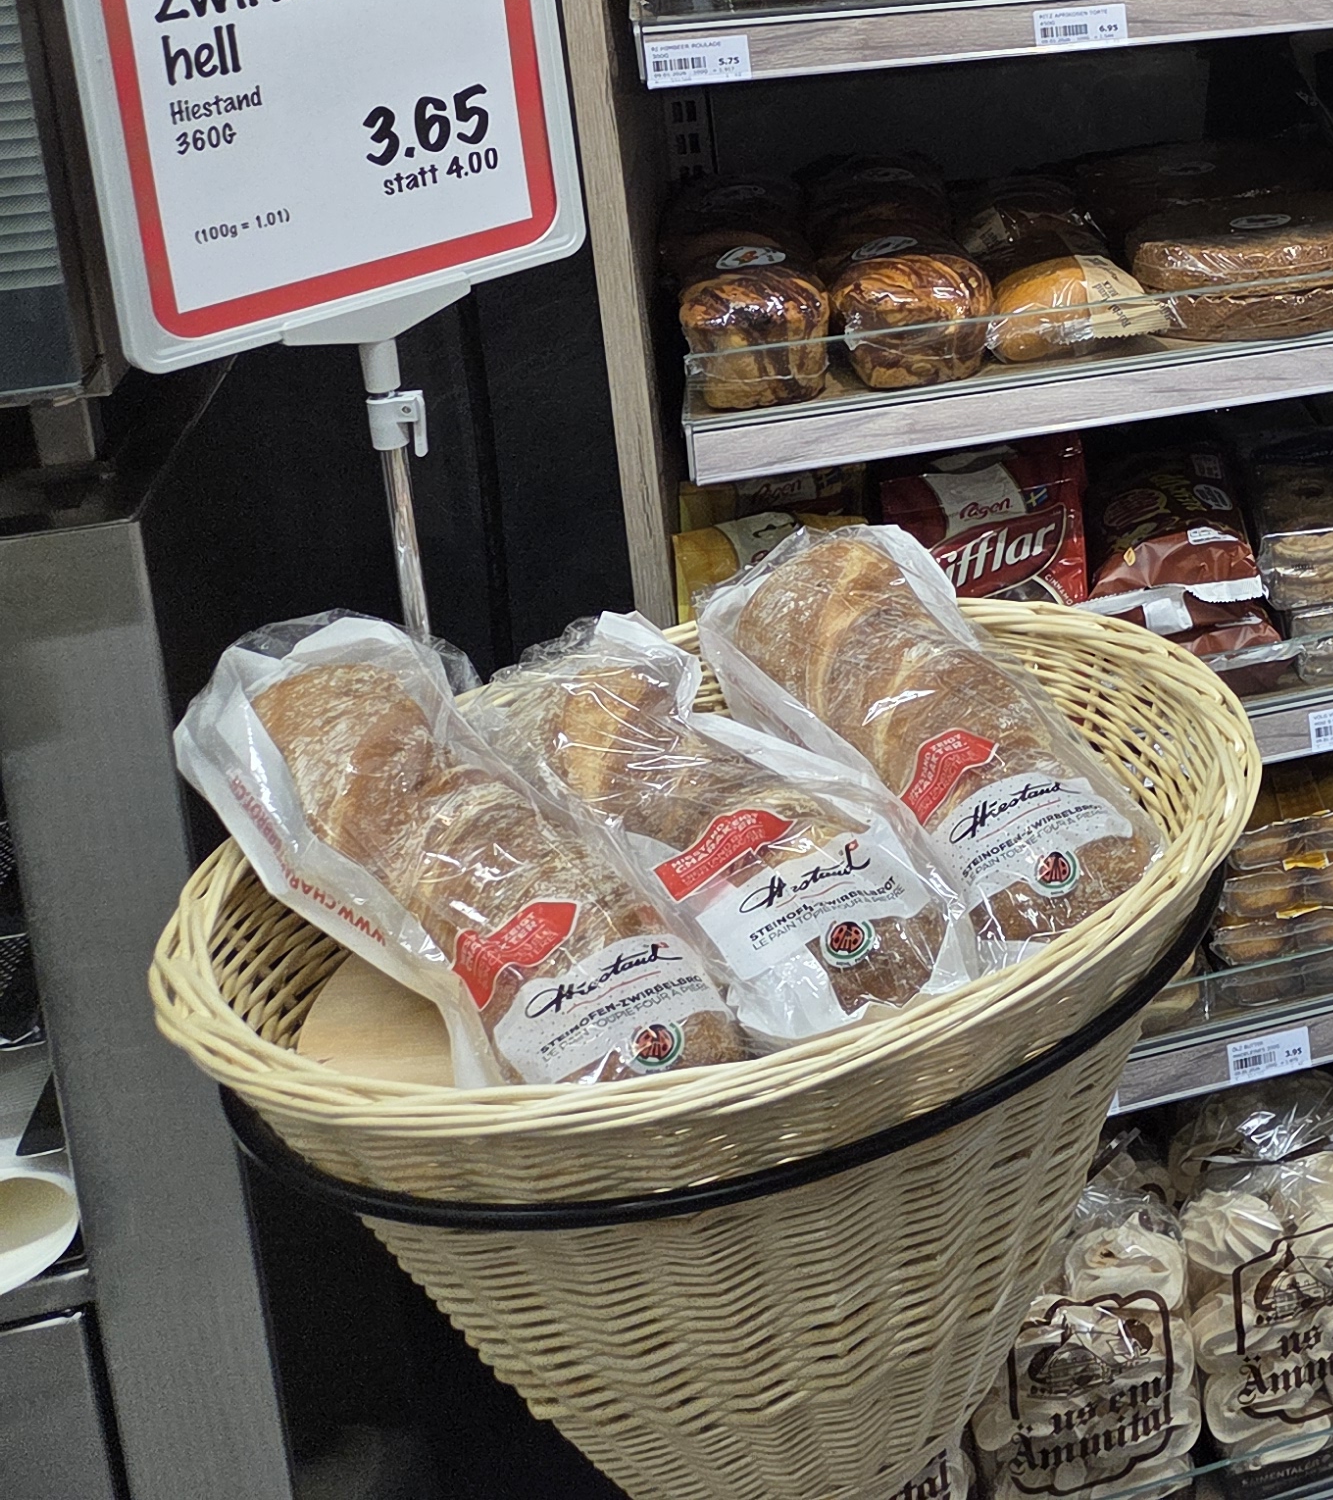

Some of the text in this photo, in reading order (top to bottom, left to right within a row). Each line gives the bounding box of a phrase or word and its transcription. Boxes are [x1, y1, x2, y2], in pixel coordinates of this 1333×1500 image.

[1099, 24, 1118, 32] 6.95
[161, 24, 242, 86] hell
[719, 57, 740, 65] 5.75
[170, 86, 263, 126] Hiestand
[363, 85, 489, 166] 3.65
[175, 126, 236, 156] 360G
[382, 146, 499, 197] statt 4.00
[194, 221, 238, 246] (100g
[254, 207, 291, 229] 1.01)
[943, 522, 1057, 588] ifflar
[950, 782, 1080, 843] Hiestand
[769, 923, 797, 943] PAIN
[525, 942, 683, 1018] Hiestand
[1285, 1048, 1302, 1057] 3.95
